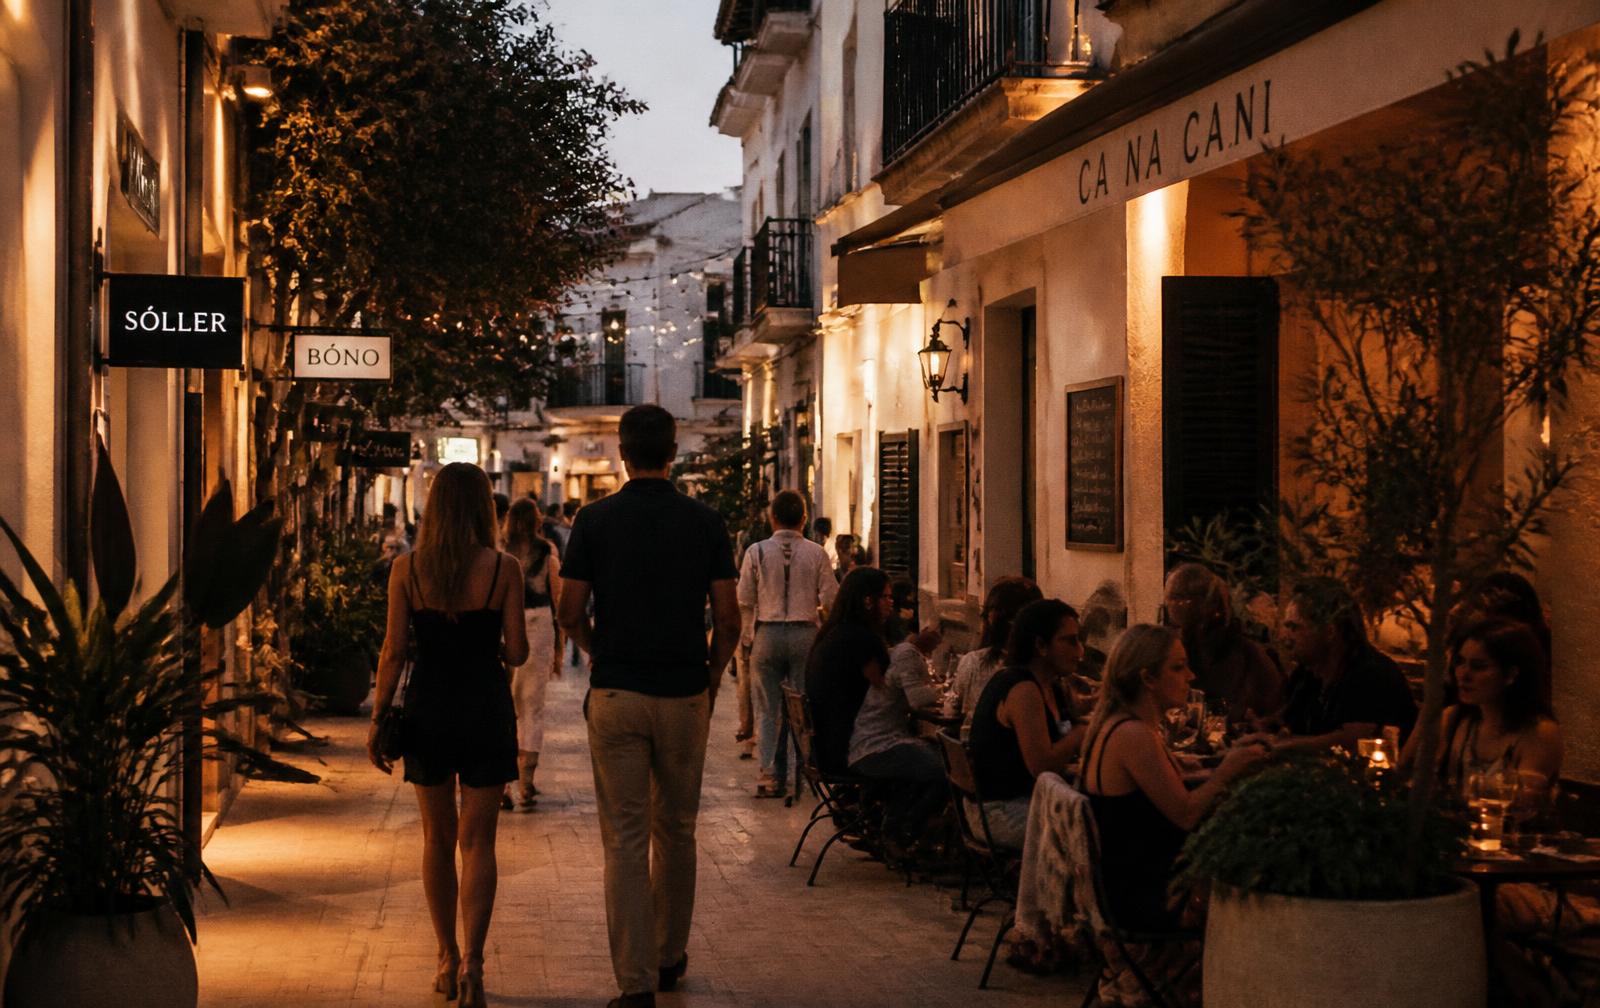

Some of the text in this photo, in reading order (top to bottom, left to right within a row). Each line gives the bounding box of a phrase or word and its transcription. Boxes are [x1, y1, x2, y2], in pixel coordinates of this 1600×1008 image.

[1078, 79, 1271, 205] CA NA CANI
[123, 304, 228, 334] SÓLLER
[307, 342, 380, 367] BÓNO
